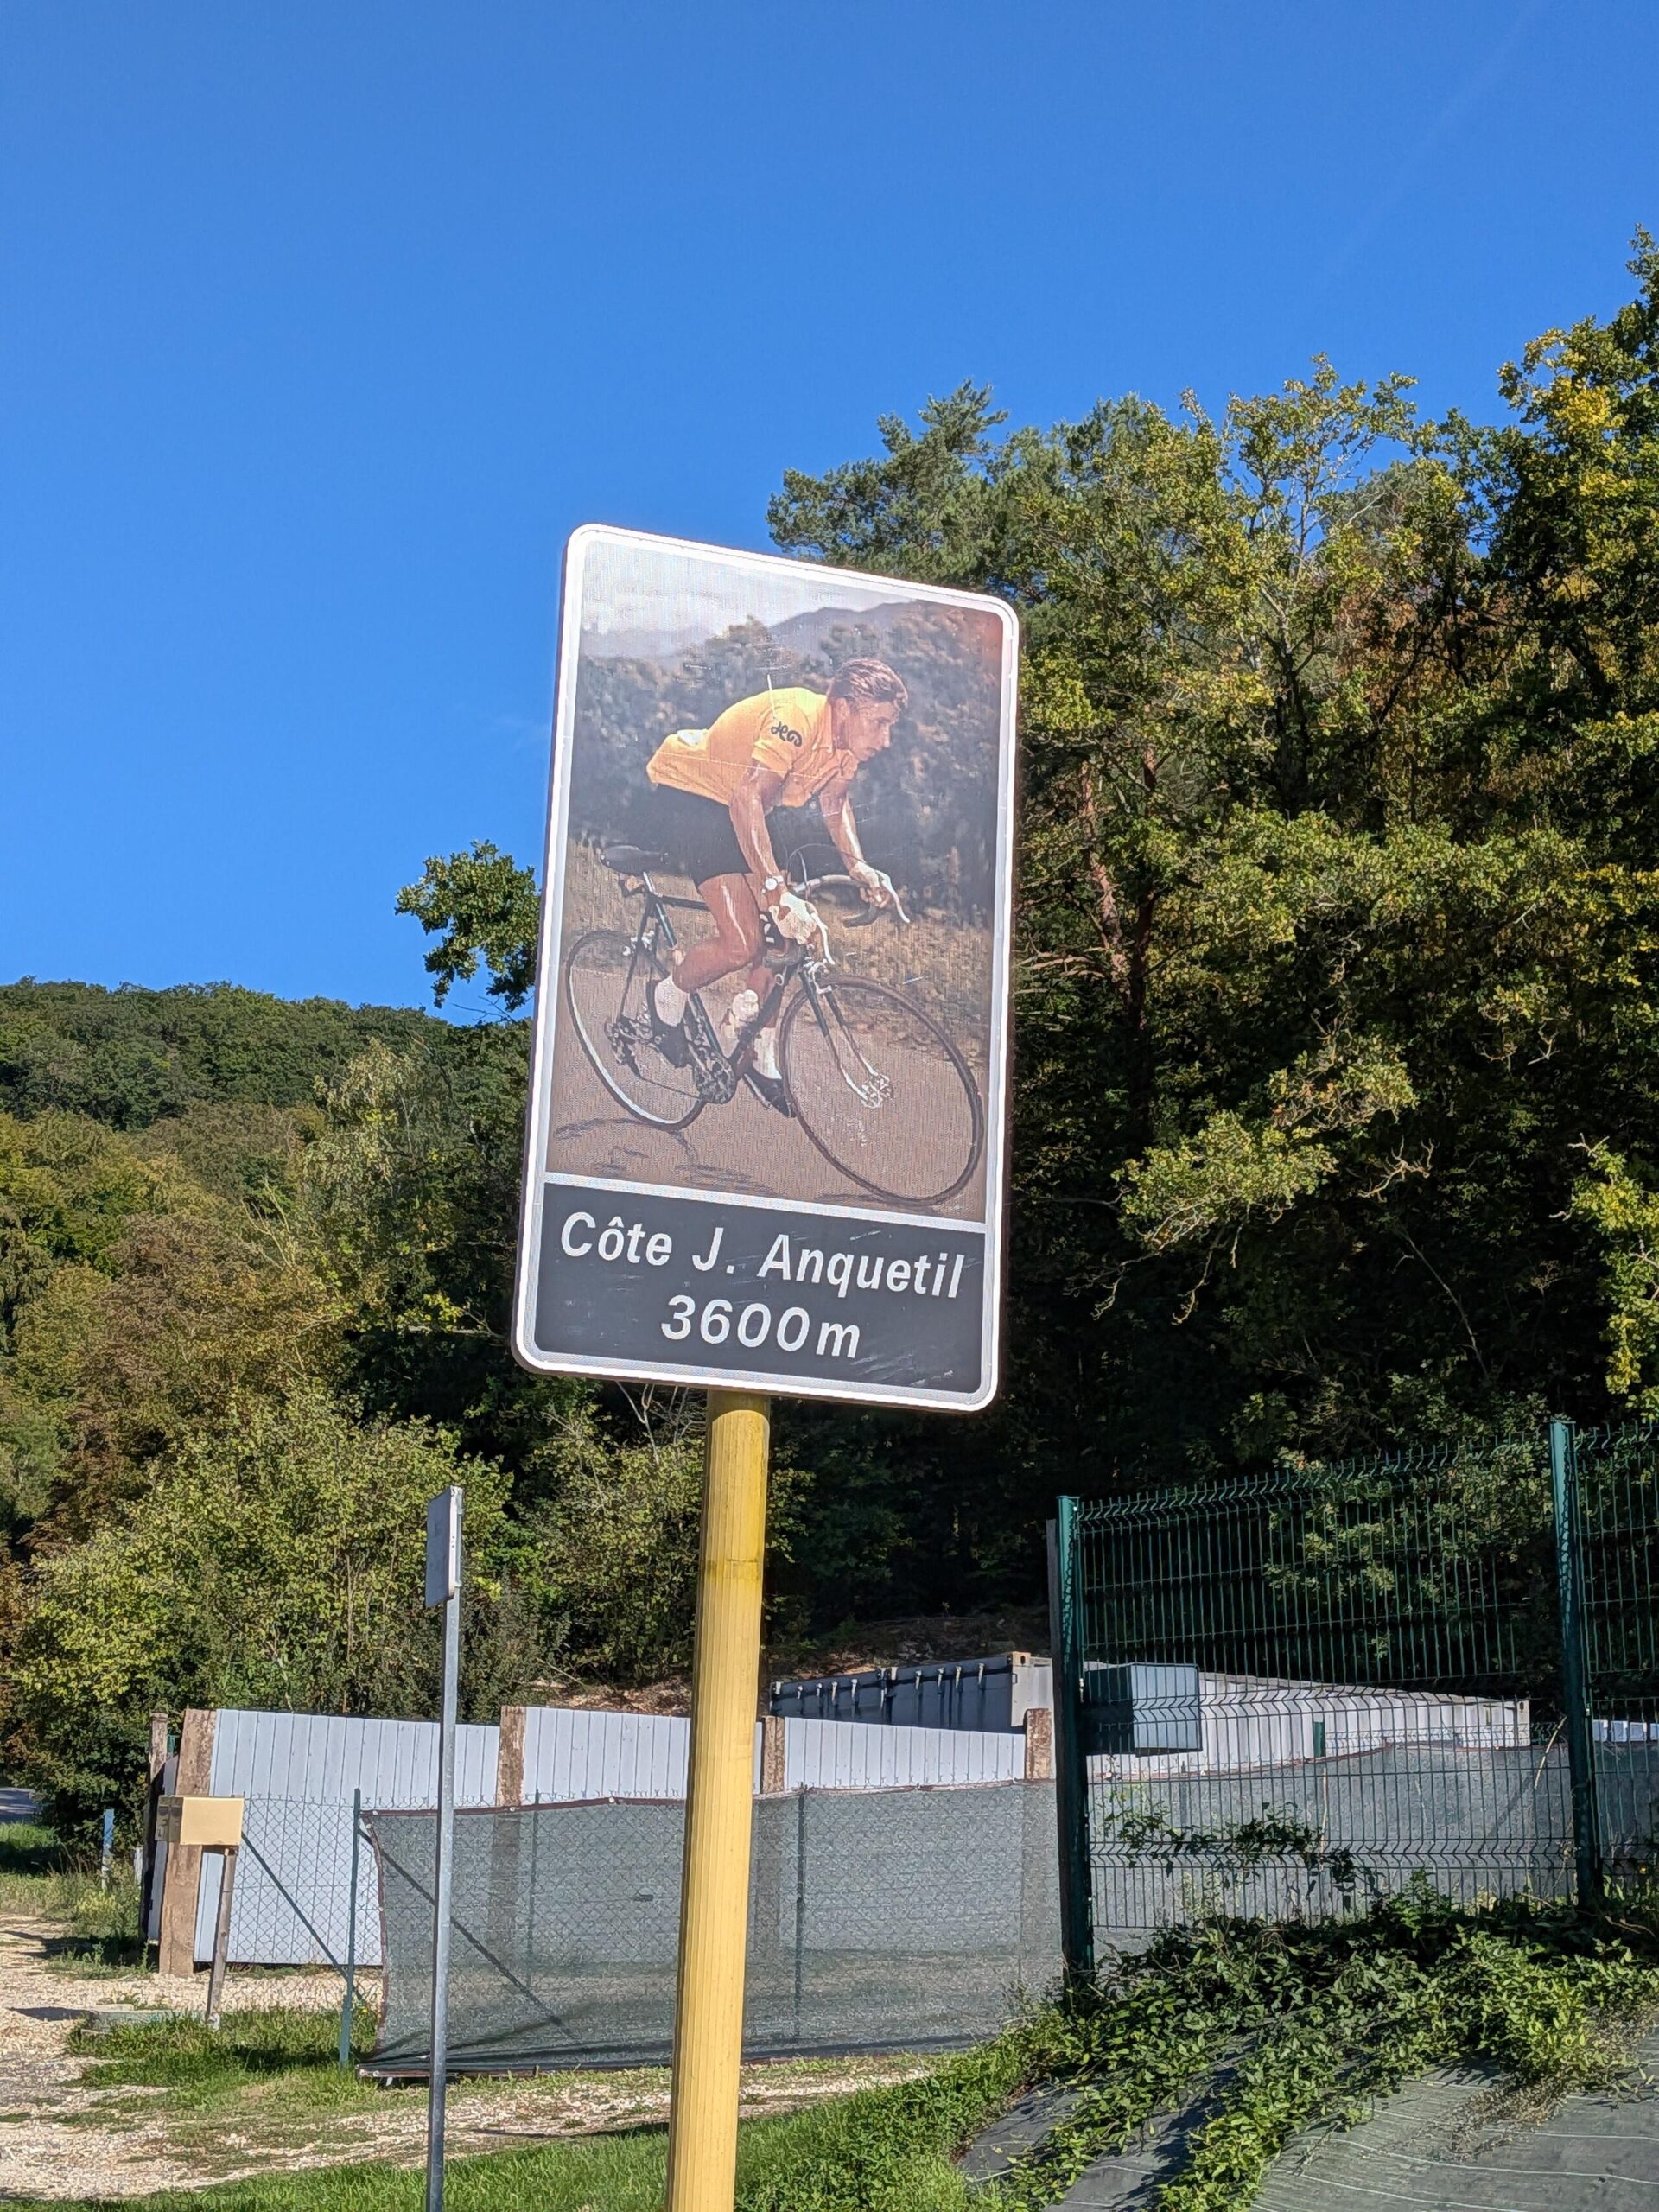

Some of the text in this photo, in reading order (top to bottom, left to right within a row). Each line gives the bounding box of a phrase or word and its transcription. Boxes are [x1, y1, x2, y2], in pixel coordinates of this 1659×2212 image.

[561, 1211, 965, 1299] Côte J. Anquetil
[661, 1294, 861, 1359] 3600m
